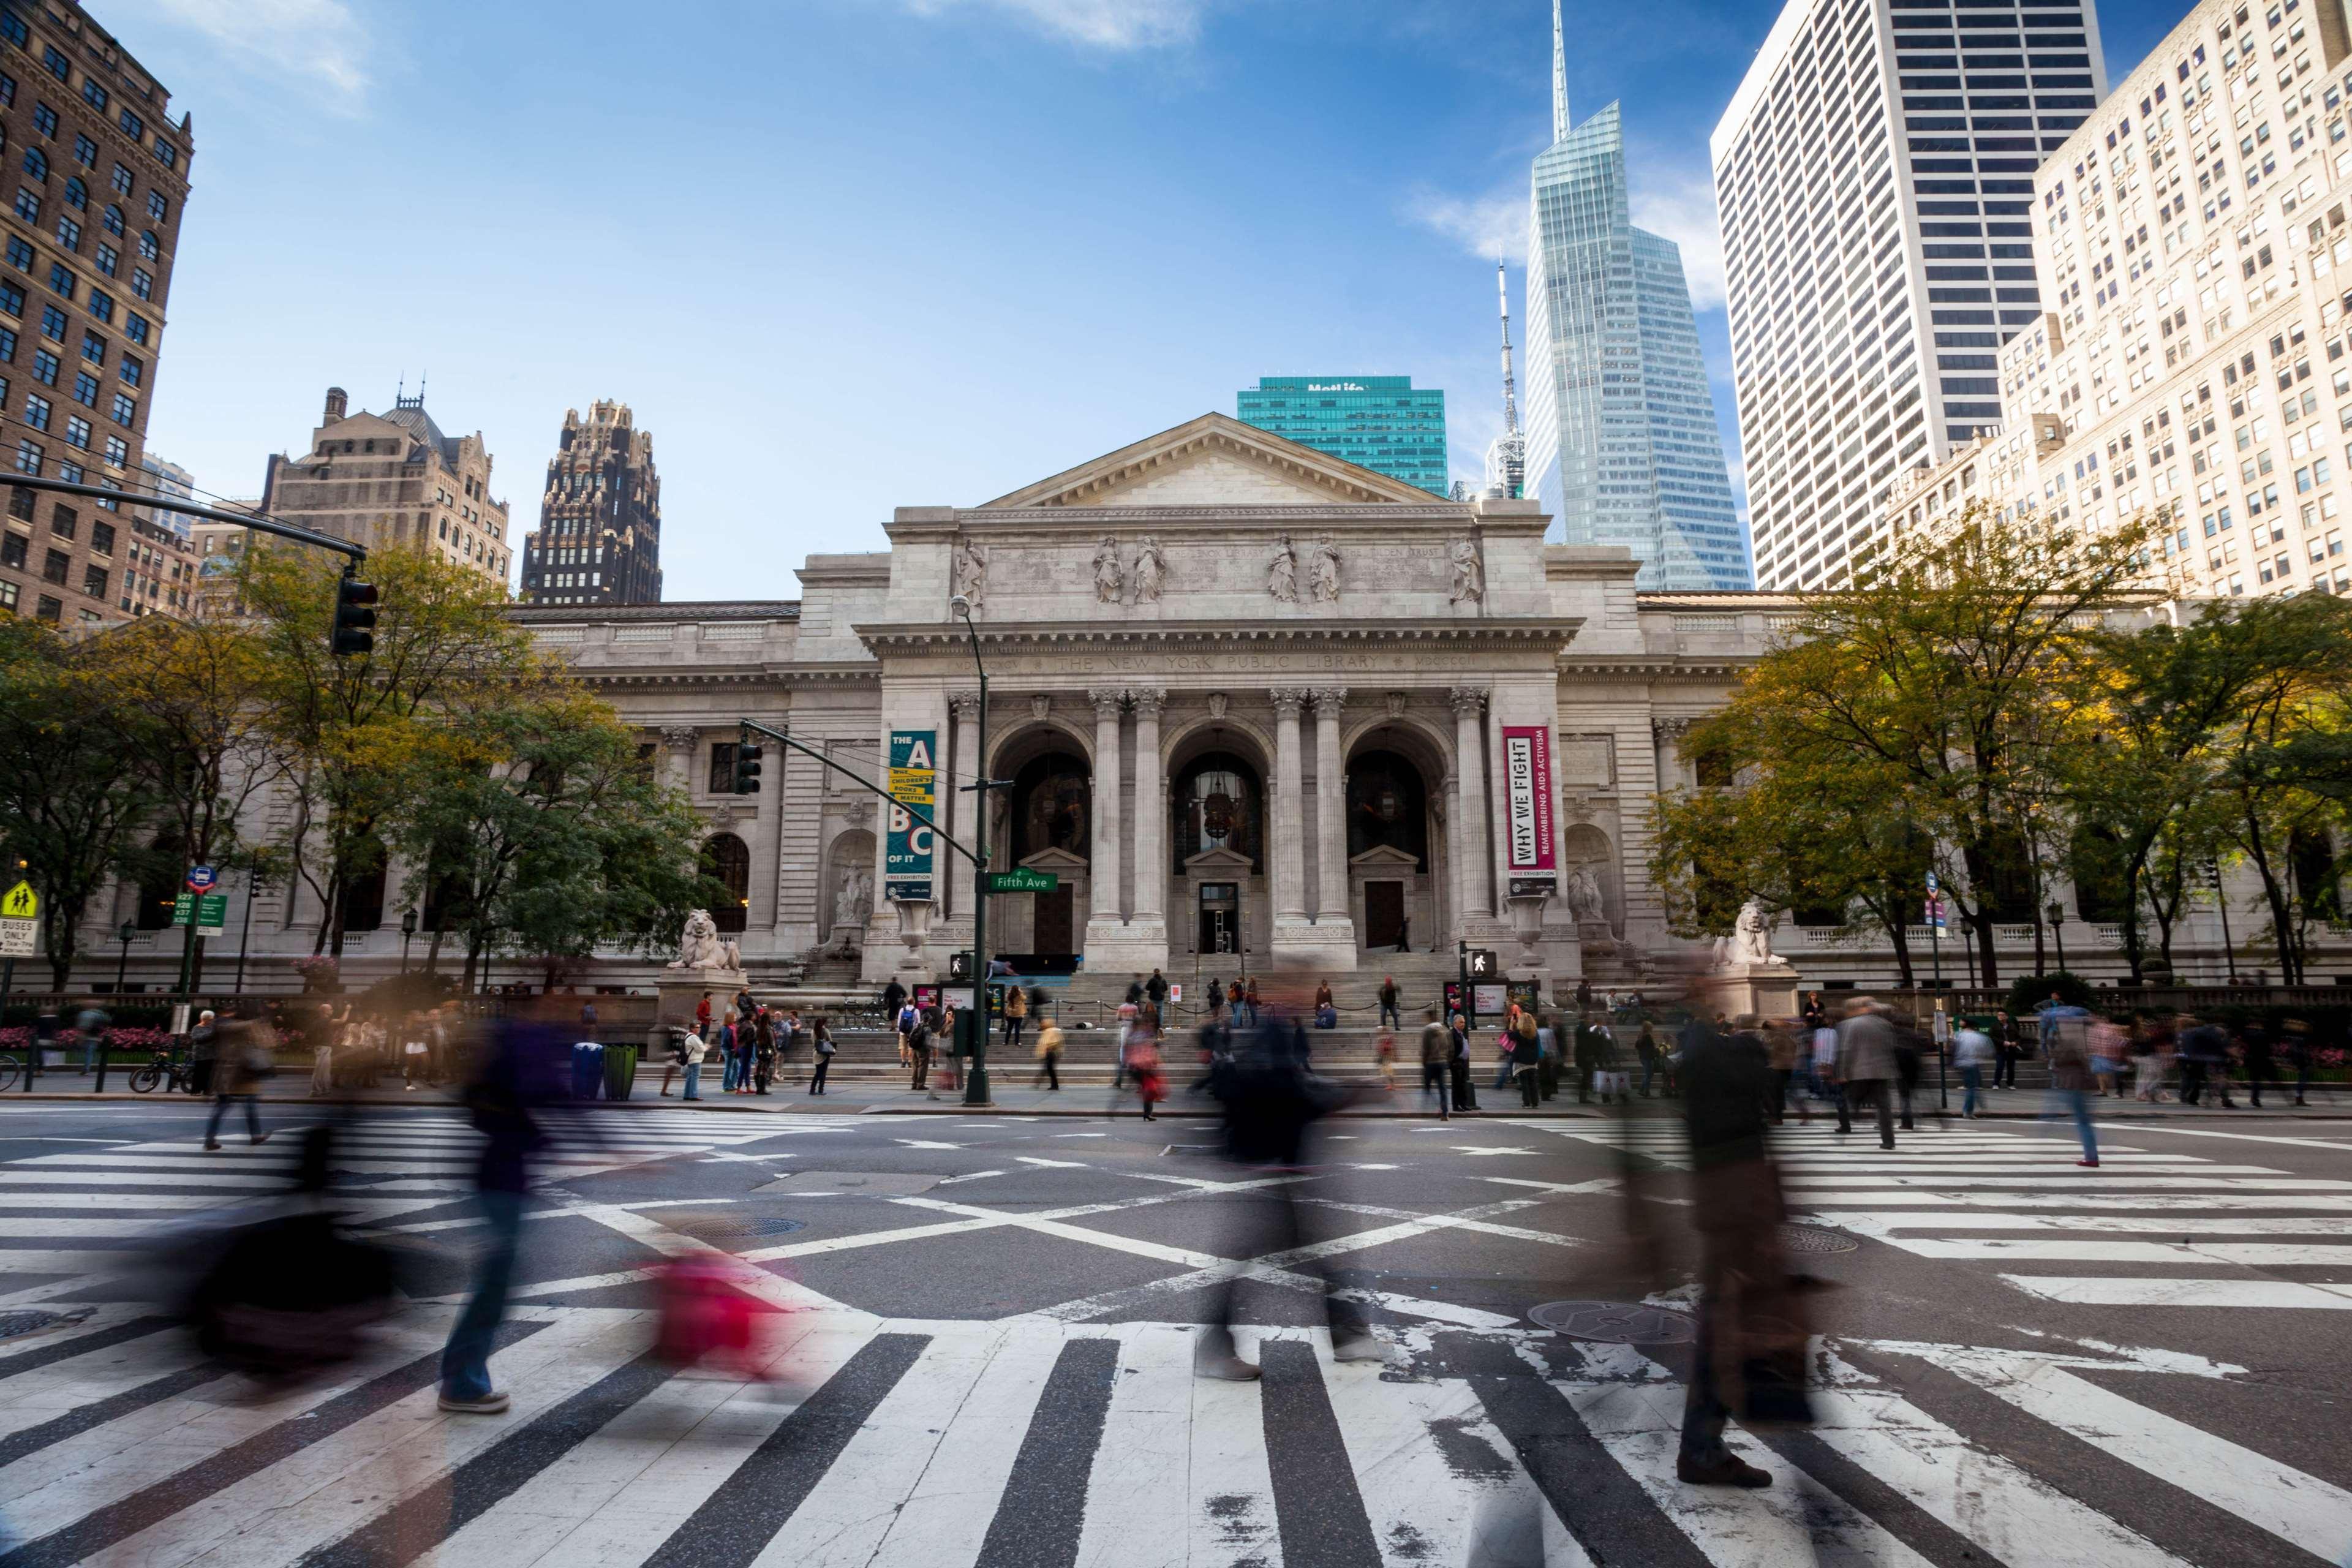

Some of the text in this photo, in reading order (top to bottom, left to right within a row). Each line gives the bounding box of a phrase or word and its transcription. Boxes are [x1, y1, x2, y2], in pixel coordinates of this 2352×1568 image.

[1057, 657, 1094, 670] THE
[1107, 657, 1152, 669] NEW
[1166, 656, 1213, 669] YORK
[1227, 655, 1290, 668] PUBLIC
[1306, 655, 1379, 668] LIBRARY
[907, 740, 932, 769] A
[1512, 742, 1531, 860] WHY WE FIGHT
[1536, 730, 1549, 854] REMEMBERING AIDS ACTIVISM
[889, 803, 910, 832] B
[909, 826, 931, 856] C
[998, 878, 1047, 888] Fifth Ave
[2, 921, 32, 930] BUSES
[4, 931, 28, 940] ONLY
